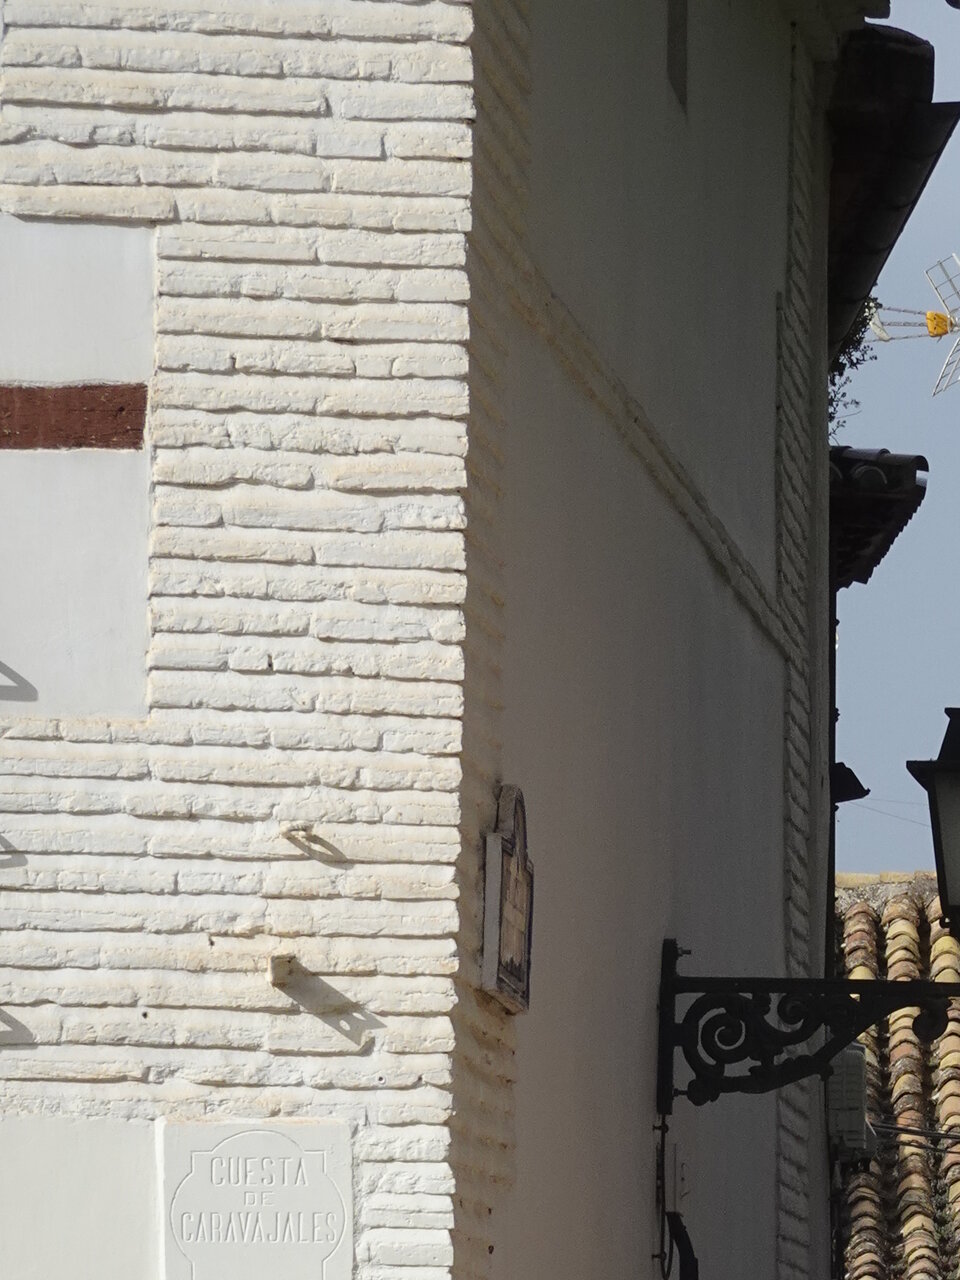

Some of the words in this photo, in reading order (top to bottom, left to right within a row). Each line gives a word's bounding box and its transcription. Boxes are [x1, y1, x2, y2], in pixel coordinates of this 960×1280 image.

[210, 1156, 309, 1187] CUESTA
[243, 1191, 275, 1207] DE
[180, 1211, 337, 1244] CARAVAJALES
